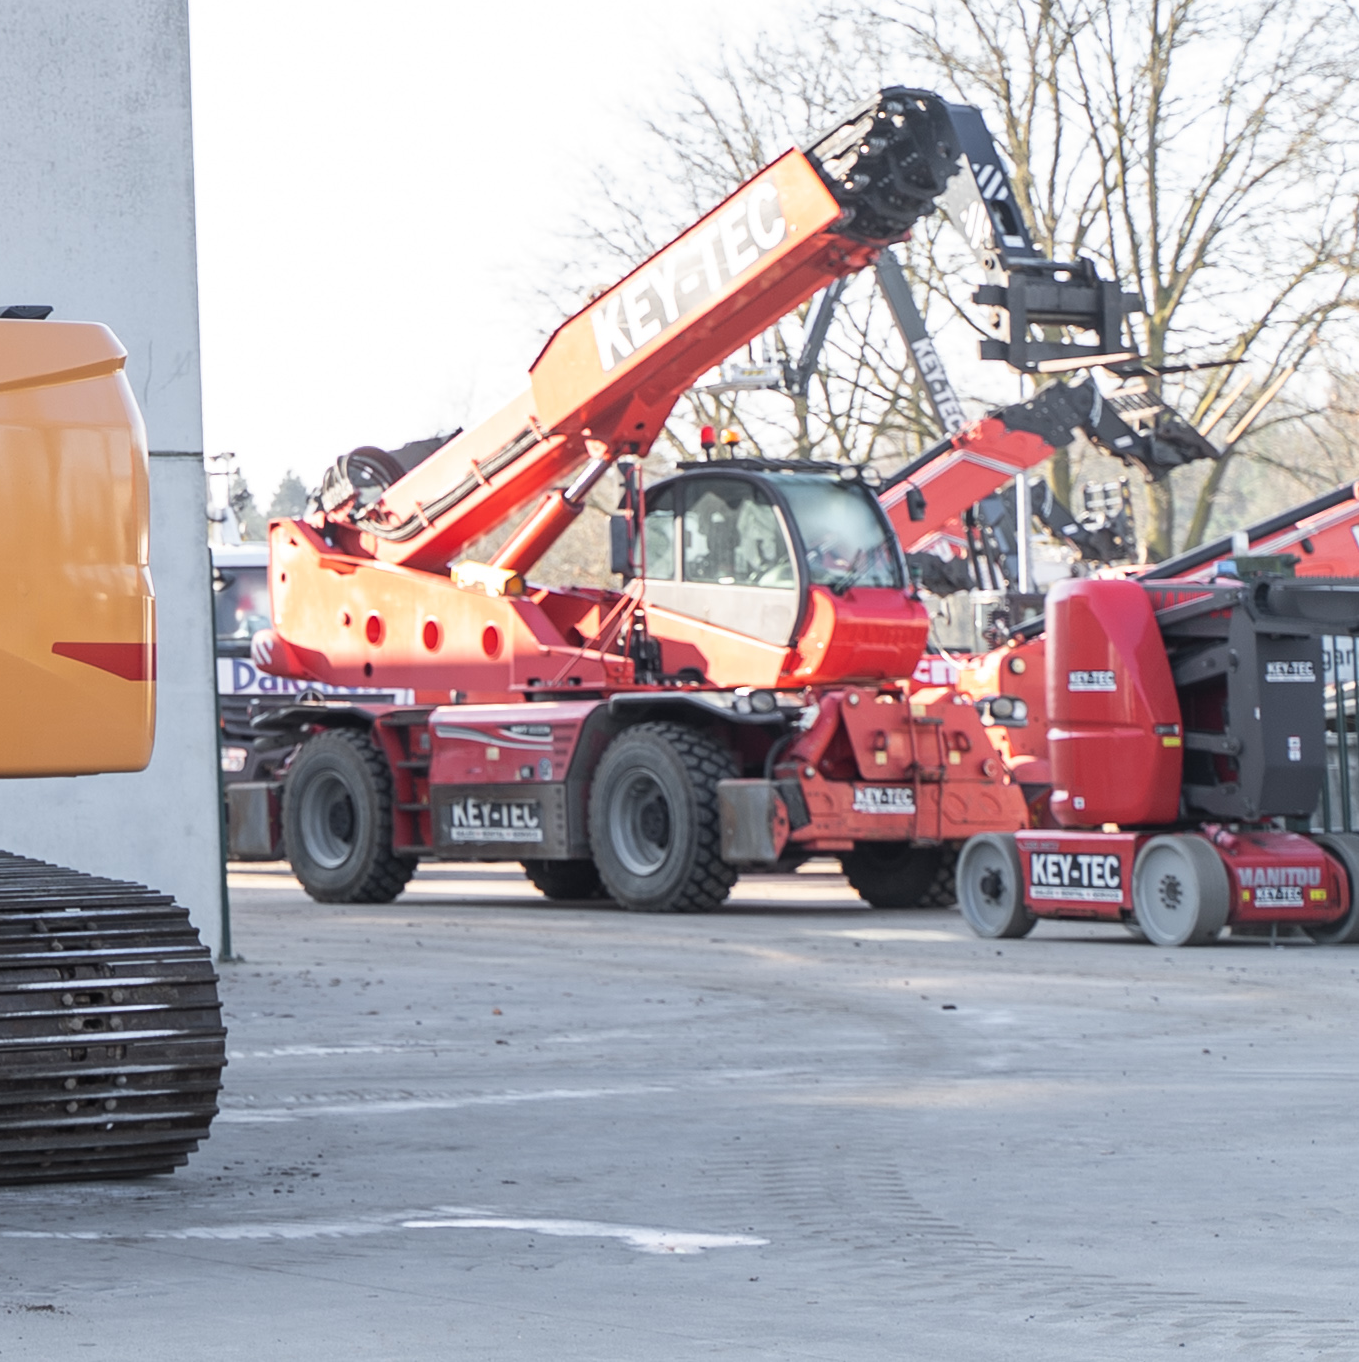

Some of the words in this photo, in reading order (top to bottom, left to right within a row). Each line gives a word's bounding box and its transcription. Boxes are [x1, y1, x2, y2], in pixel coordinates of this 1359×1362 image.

[589, 181, 787, 373] KEY-TEC
[910, 337, 965, 434] KEY-TEC
[1069, 671, 1115, 686] KEY-TEC
[1267, 661, 1314, 676] KEY-TEC
[1031, 852, 1120, 888] KEY-TEC
[1237, 866, 1321, 886] MANITOU
[1255, 886, 1303, 902] KEY-TEC
